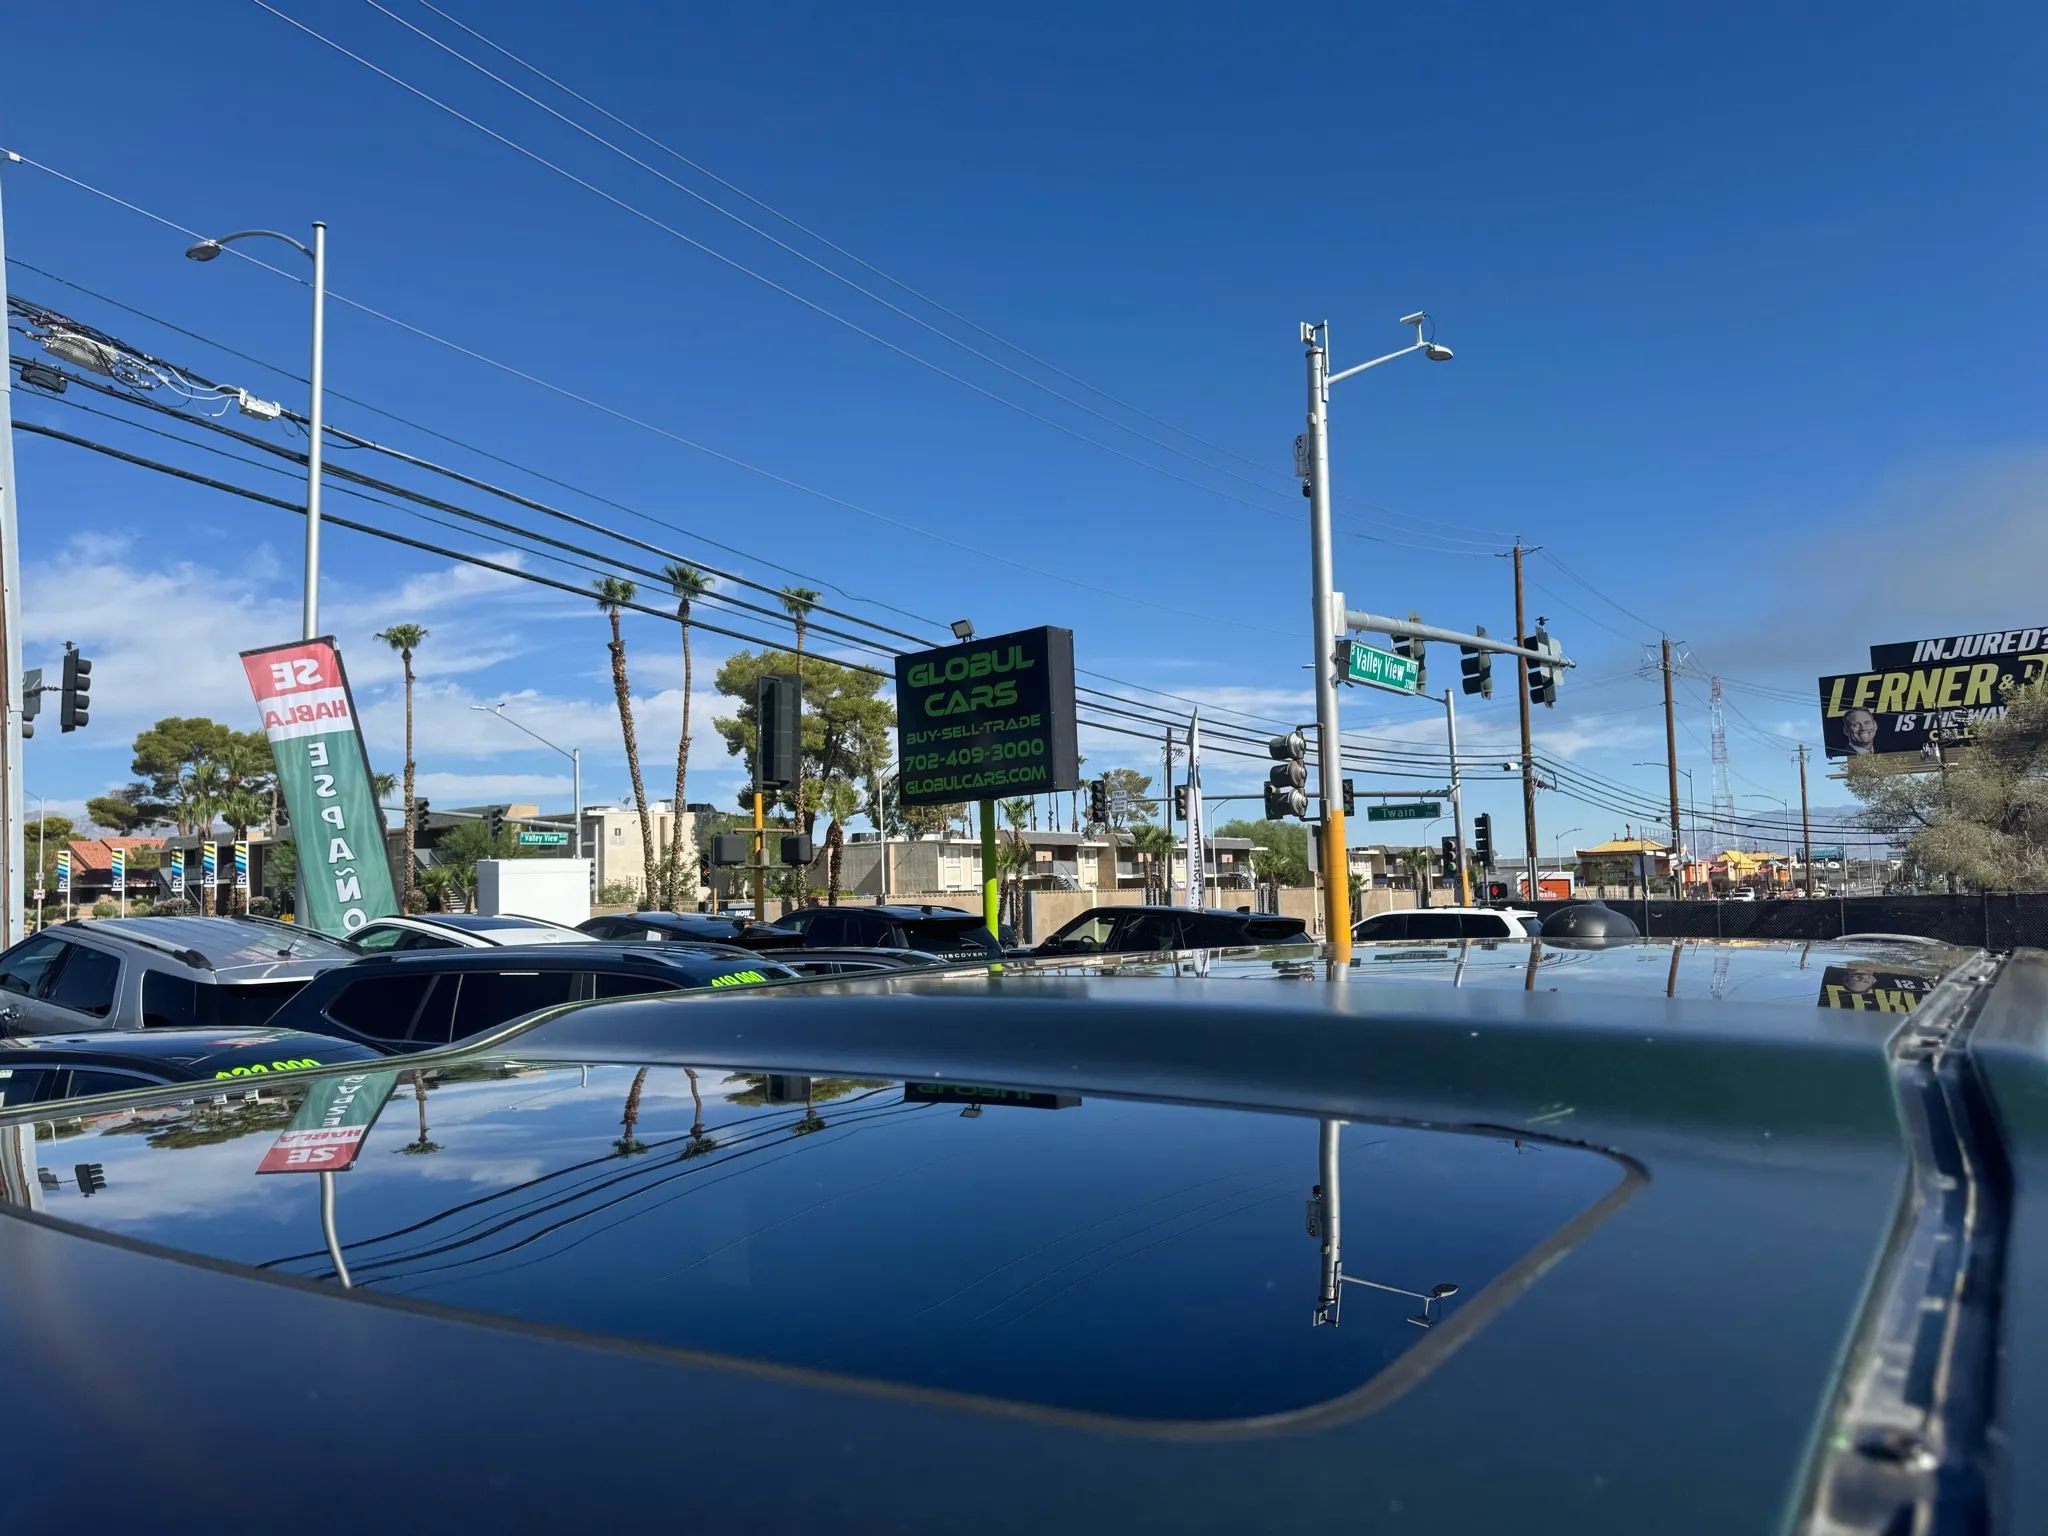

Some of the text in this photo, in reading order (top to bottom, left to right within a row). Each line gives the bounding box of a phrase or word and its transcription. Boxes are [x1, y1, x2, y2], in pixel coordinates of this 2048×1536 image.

[908, 645, 1035, 688] GLOBUL
[1356, 647, 1383, 681] Valley
[1385, 655, 1405, 682] View
[924, 680, 1018, 717] CARS
[1827, 664, 1999, 718] LERNER
[906, 714, 1041, 745] BUY-SELL-TRADE
[1895, 713, 1917, 732] IS
[904, 738, 1044, 773] 702-409-3000
[905, 765, 1047, 795] GLOBULCARS.COM
[1381, 808, 1416, 818] Twain
[525, 833, 543, 843] Valley
[544, 834, 559, 842] View
